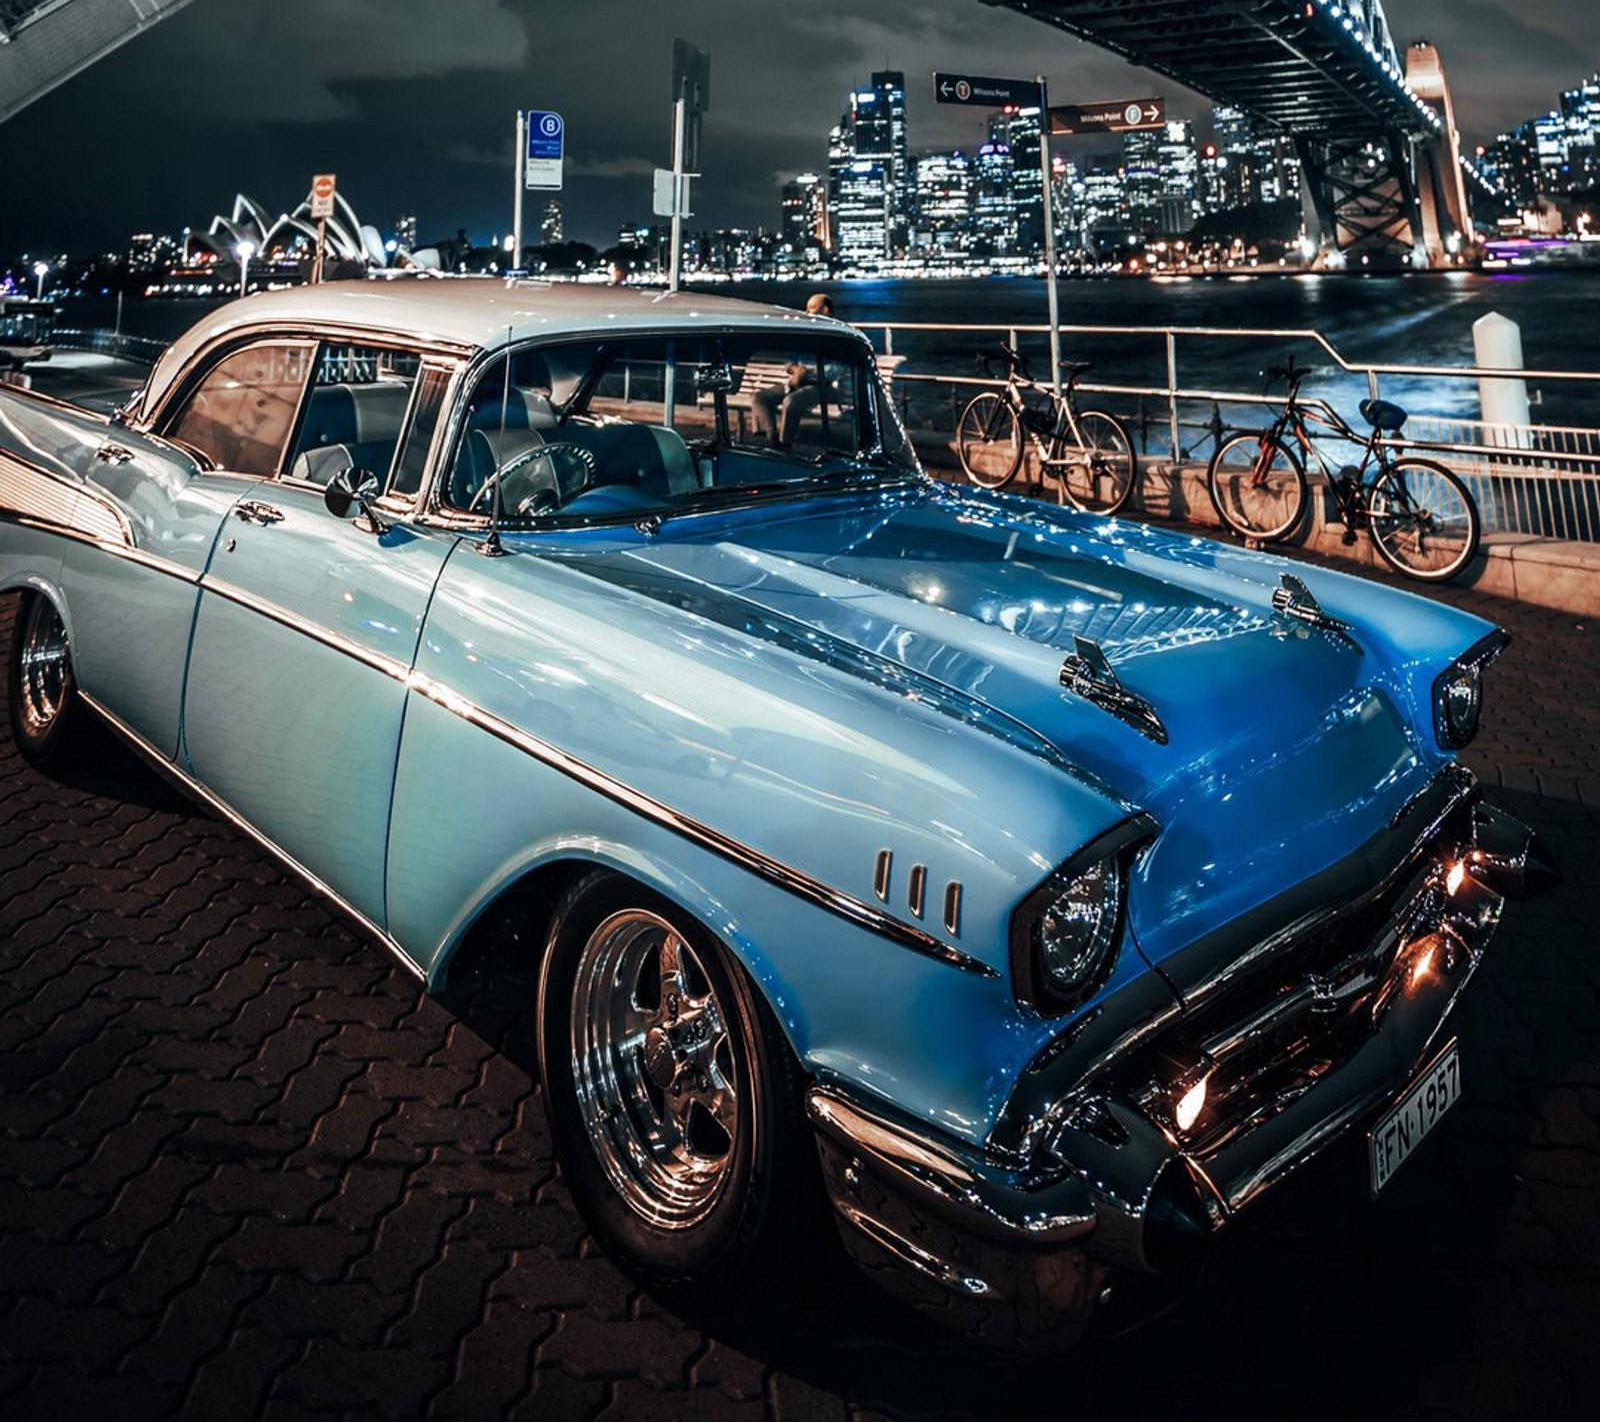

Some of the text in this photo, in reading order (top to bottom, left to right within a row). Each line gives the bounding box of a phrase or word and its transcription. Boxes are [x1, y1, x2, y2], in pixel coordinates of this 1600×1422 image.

[959, 84, 1010, 98] T Milsons Point
[1080, 114, 1104, 123] Milsons
[1104, 111, 1121, 121] Point
[546, 119, 556, 132] B
